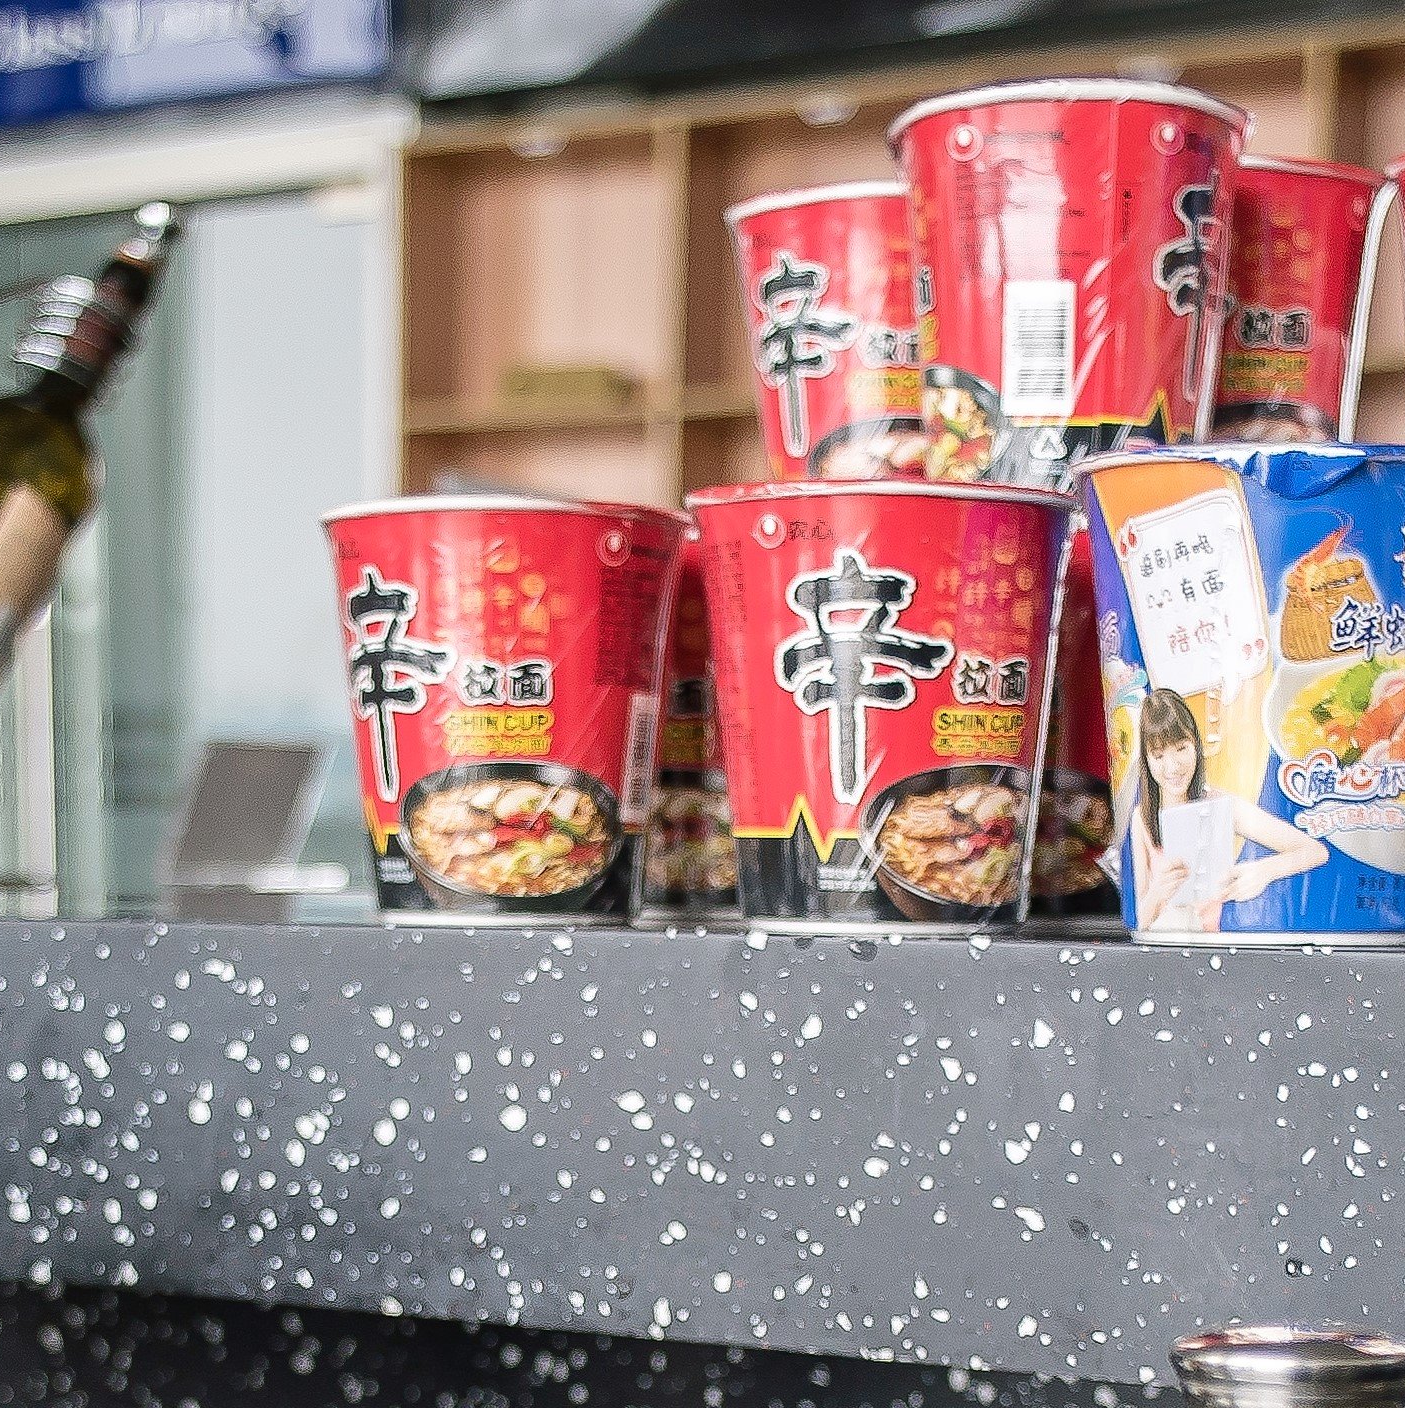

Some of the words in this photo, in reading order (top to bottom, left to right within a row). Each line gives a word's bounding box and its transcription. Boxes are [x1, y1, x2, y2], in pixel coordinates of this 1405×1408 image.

[759, 254, 855, 455] 辛
[349, 572, 449, 796] 辛
[463, 662, 551, 702] 拉面
[782, 554, 948, 798] 辛
[937, 712, 987, 732] SHIN
[958, 657, 1027, 703] 拉面
